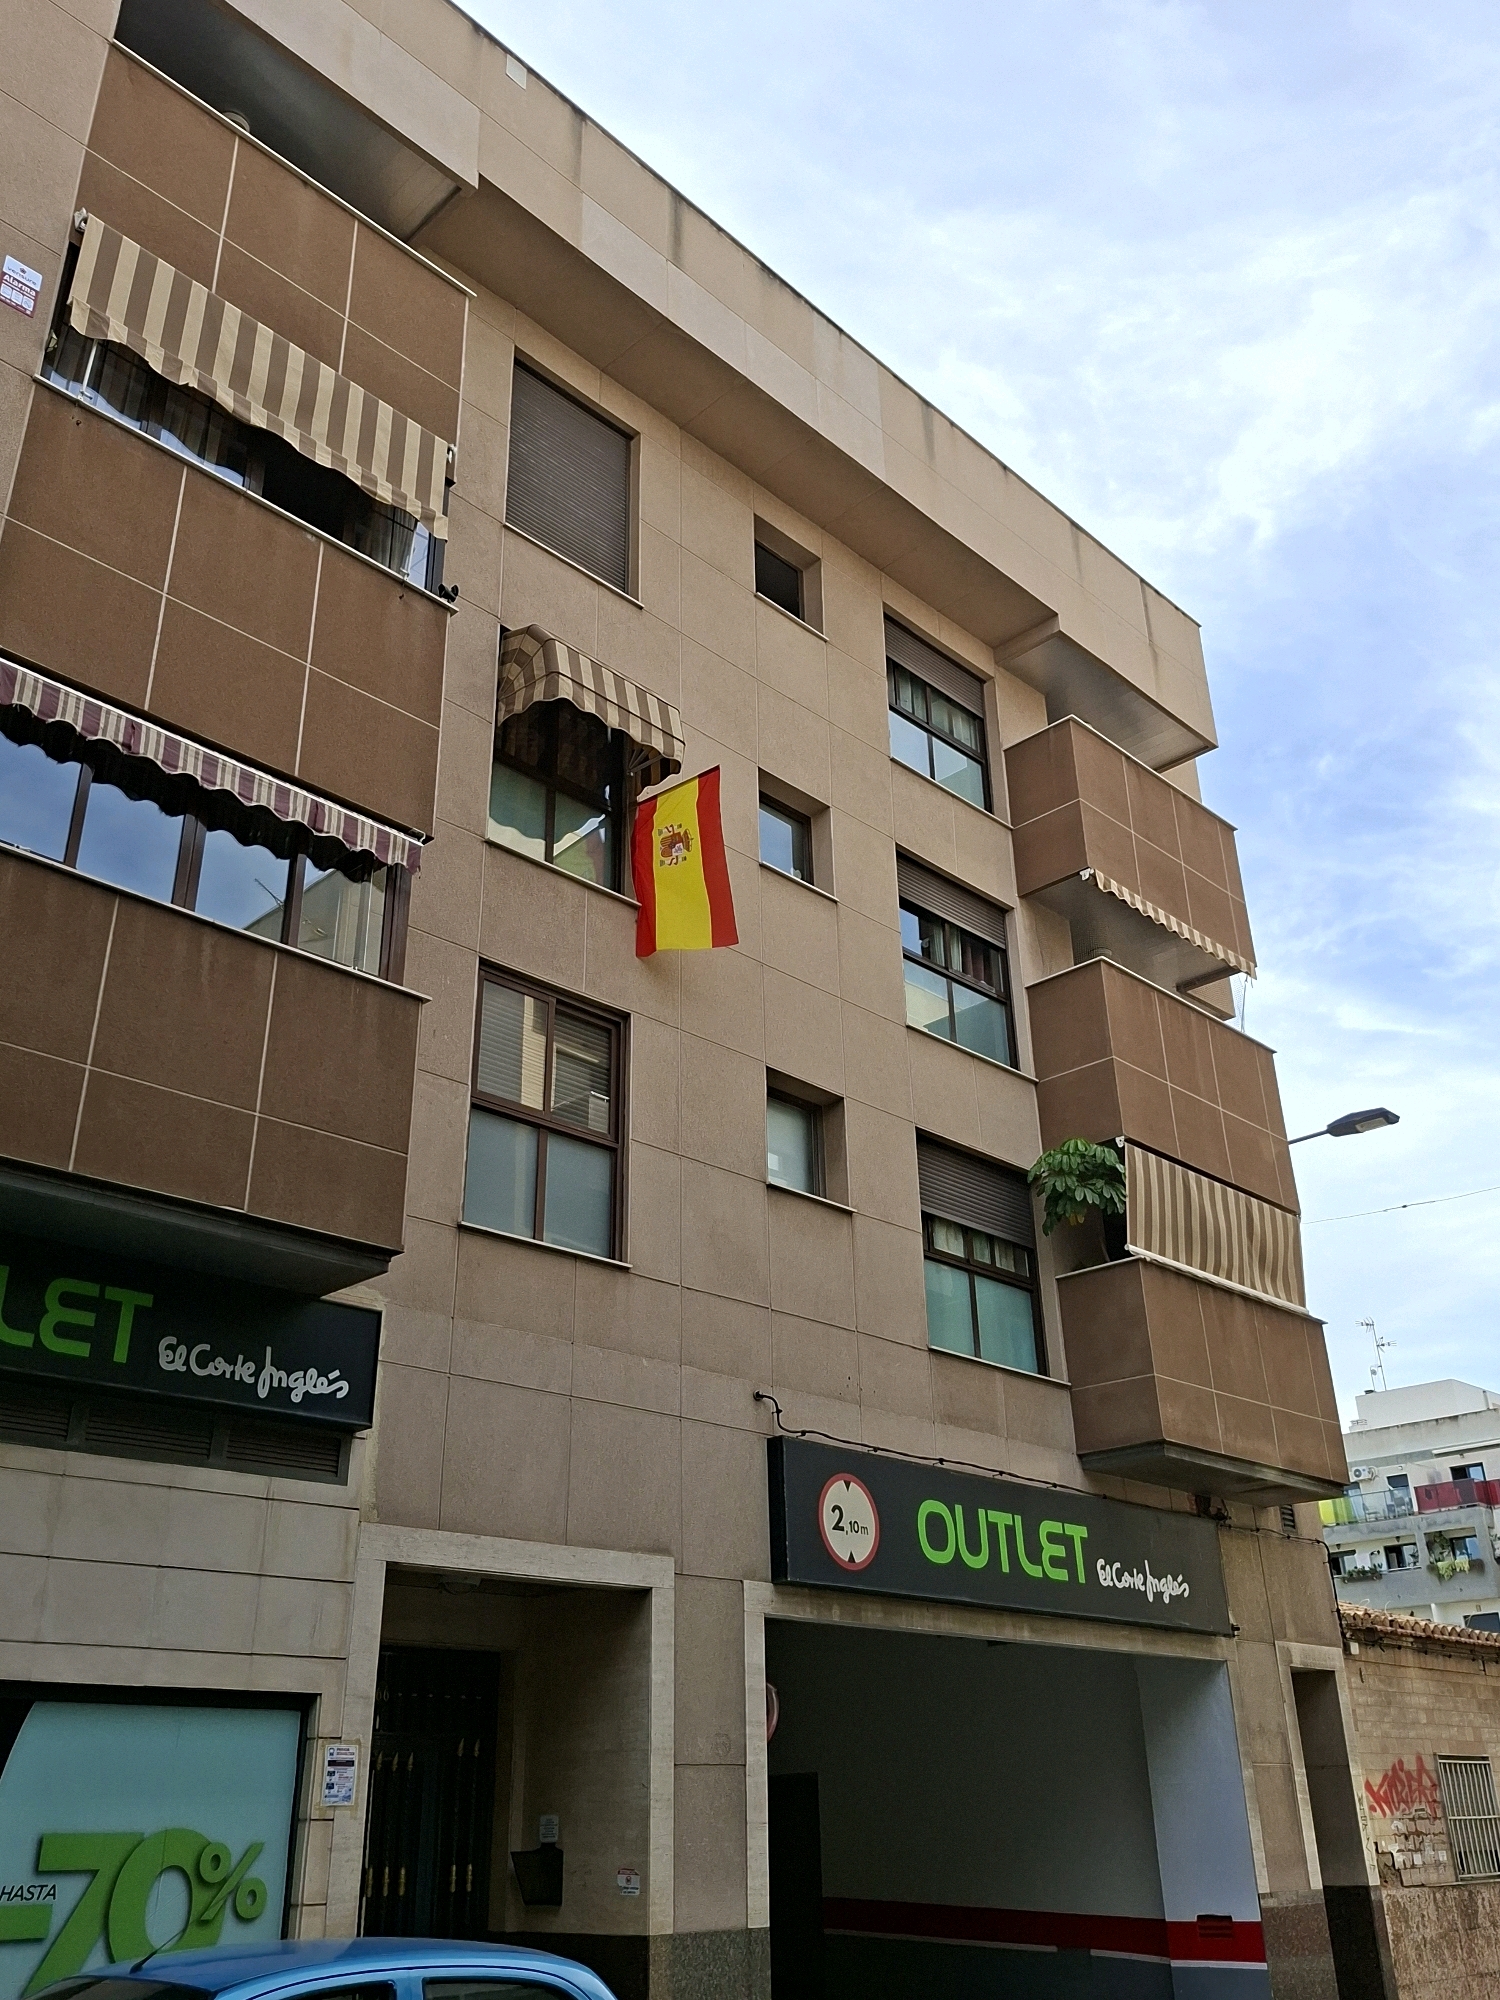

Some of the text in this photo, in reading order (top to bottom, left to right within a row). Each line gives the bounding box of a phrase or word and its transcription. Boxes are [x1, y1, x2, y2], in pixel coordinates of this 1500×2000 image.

[3, 274, 36, 297] Alarma
[158, 1336, 349, 1403] El Corte Inglés
[917, 1499, 1088, 1584] OUTLET
[1096, 1558, 1190, 1604] El Corte Inglés
[0, 1883, 57, 1901] HASTA
